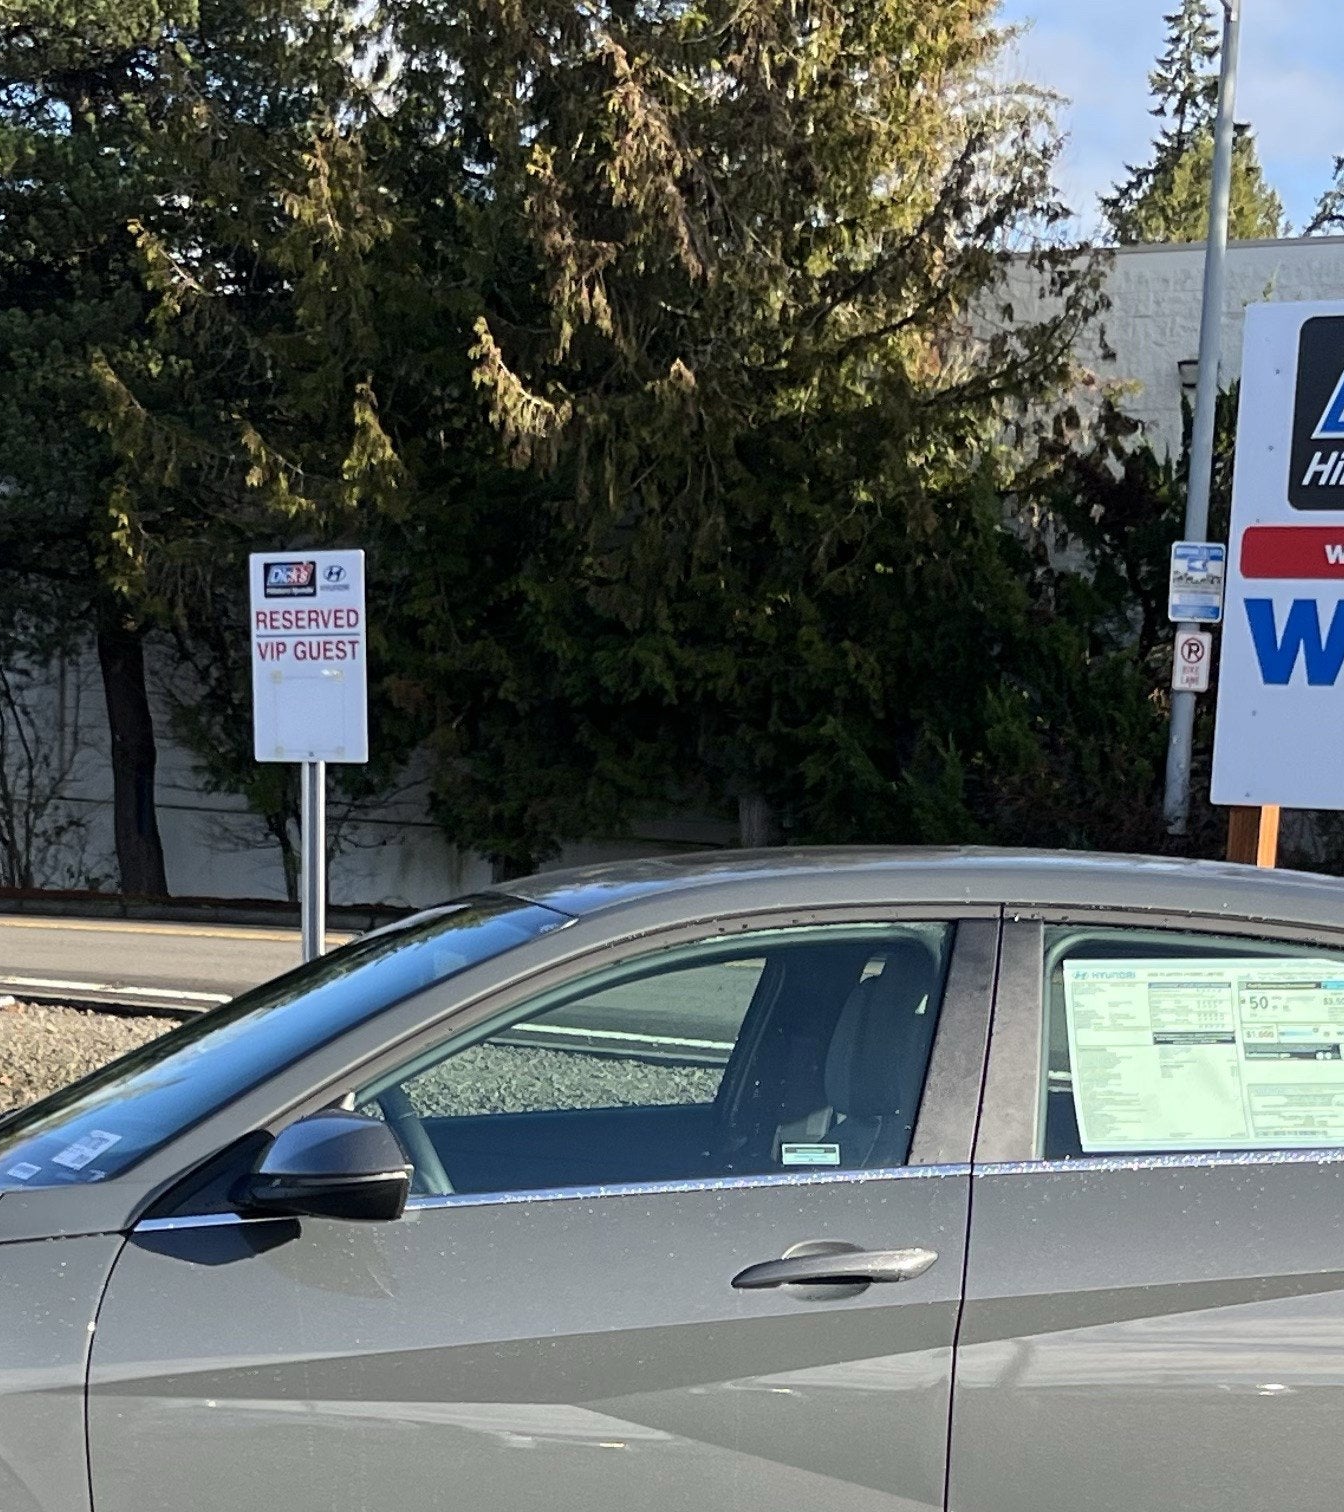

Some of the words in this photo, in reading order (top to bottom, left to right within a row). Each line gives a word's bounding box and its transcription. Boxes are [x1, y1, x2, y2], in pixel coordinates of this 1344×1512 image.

[256, 607, 360, 630] RESERVED
[257, 640, 287, 661] VIP
[293, 640, 360, 661] GUEST
[1249, 996, 1269, 1010] 50
